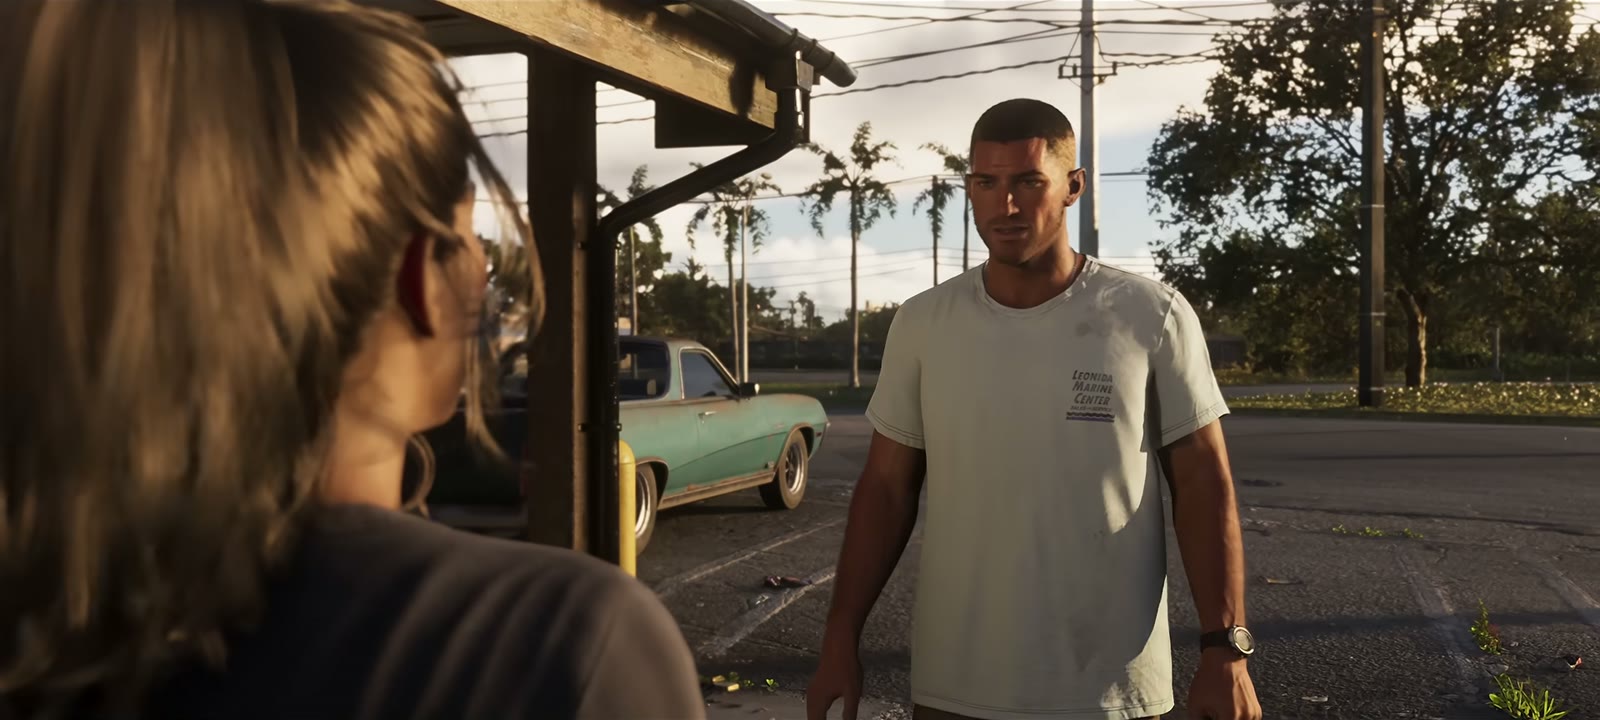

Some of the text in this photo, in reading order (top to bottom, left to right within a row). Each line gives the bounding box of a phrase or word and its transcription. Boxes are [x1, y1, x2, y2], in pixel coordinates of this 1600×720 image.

[1072, 370, 1113, 383] LEONIDA
[1072, 381, 1113, 394] MARINE
[1074, 393, 1111, 405] CENTER
